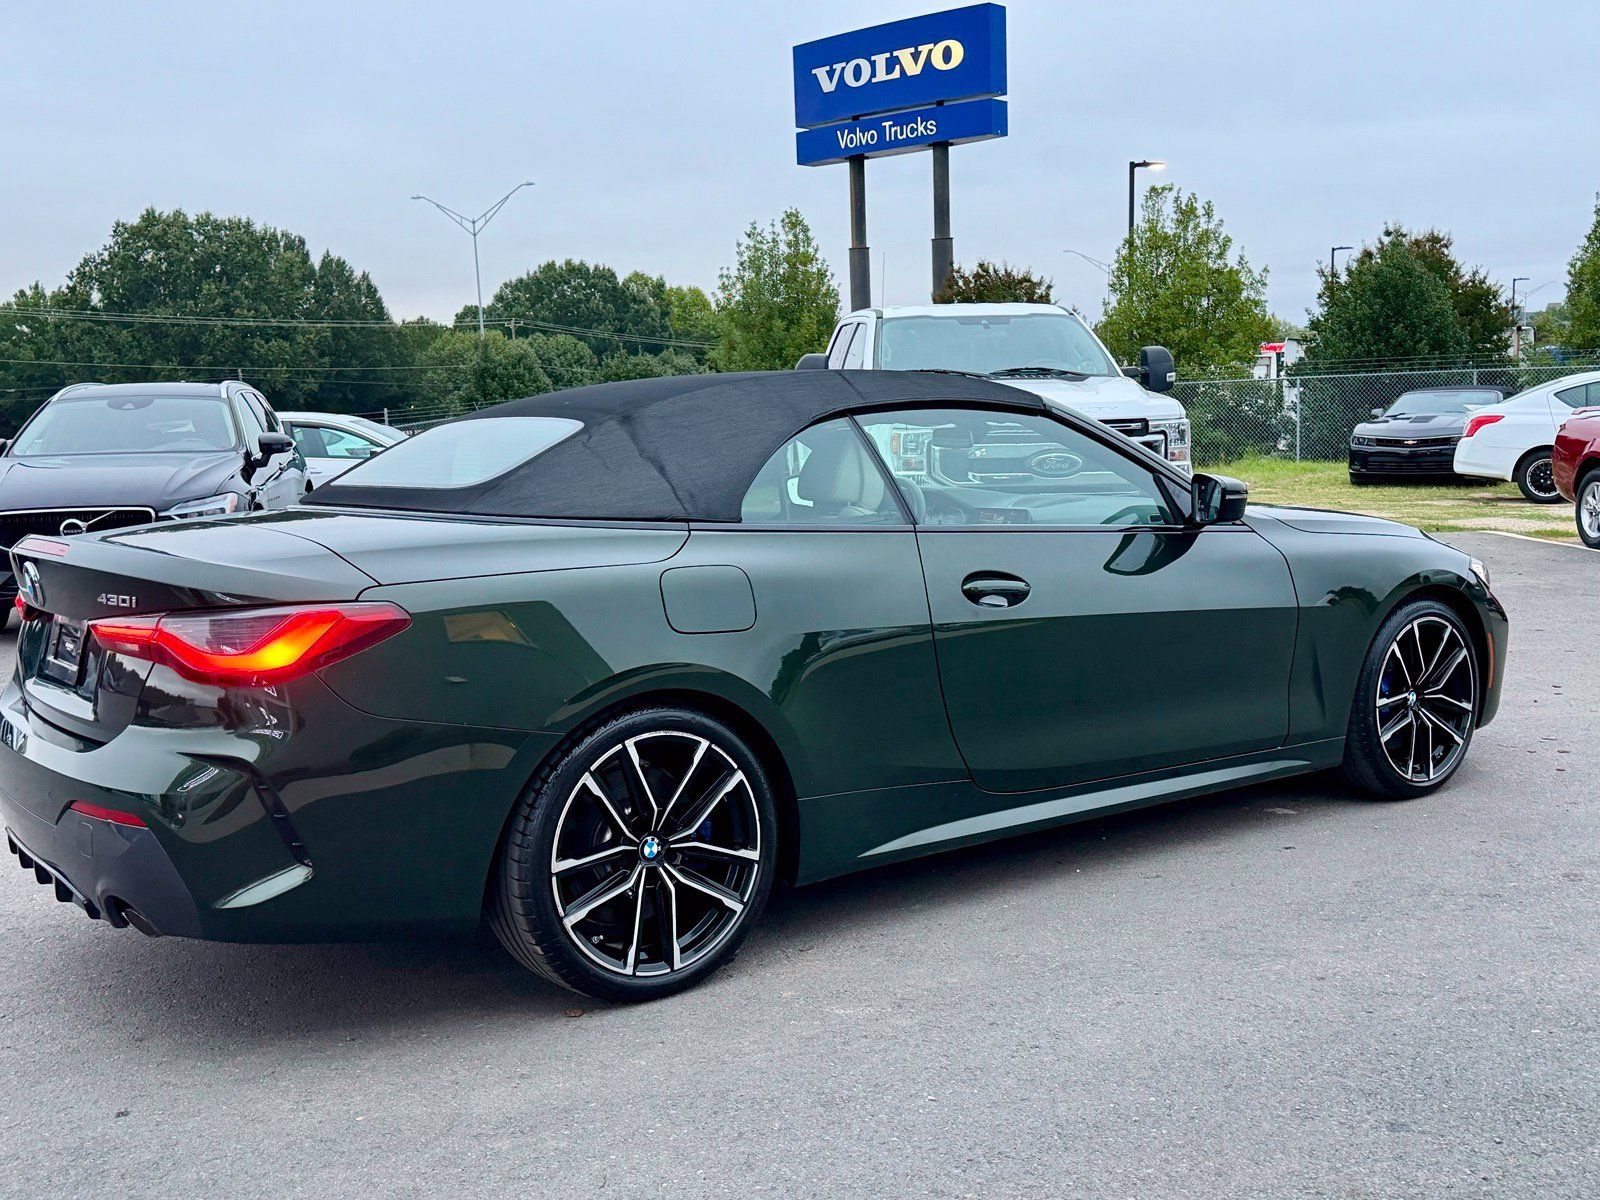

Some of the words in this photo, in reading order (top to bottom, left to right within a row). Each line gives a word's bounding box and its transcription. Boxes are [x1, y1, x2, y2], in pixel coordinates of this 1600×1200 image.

[812, 39, 964, 93] VOLVO
[837, 127, 878, 149] Volvo
[881, 116, 937, 142] Trucks
[97, 593, 137, 608] 430i
